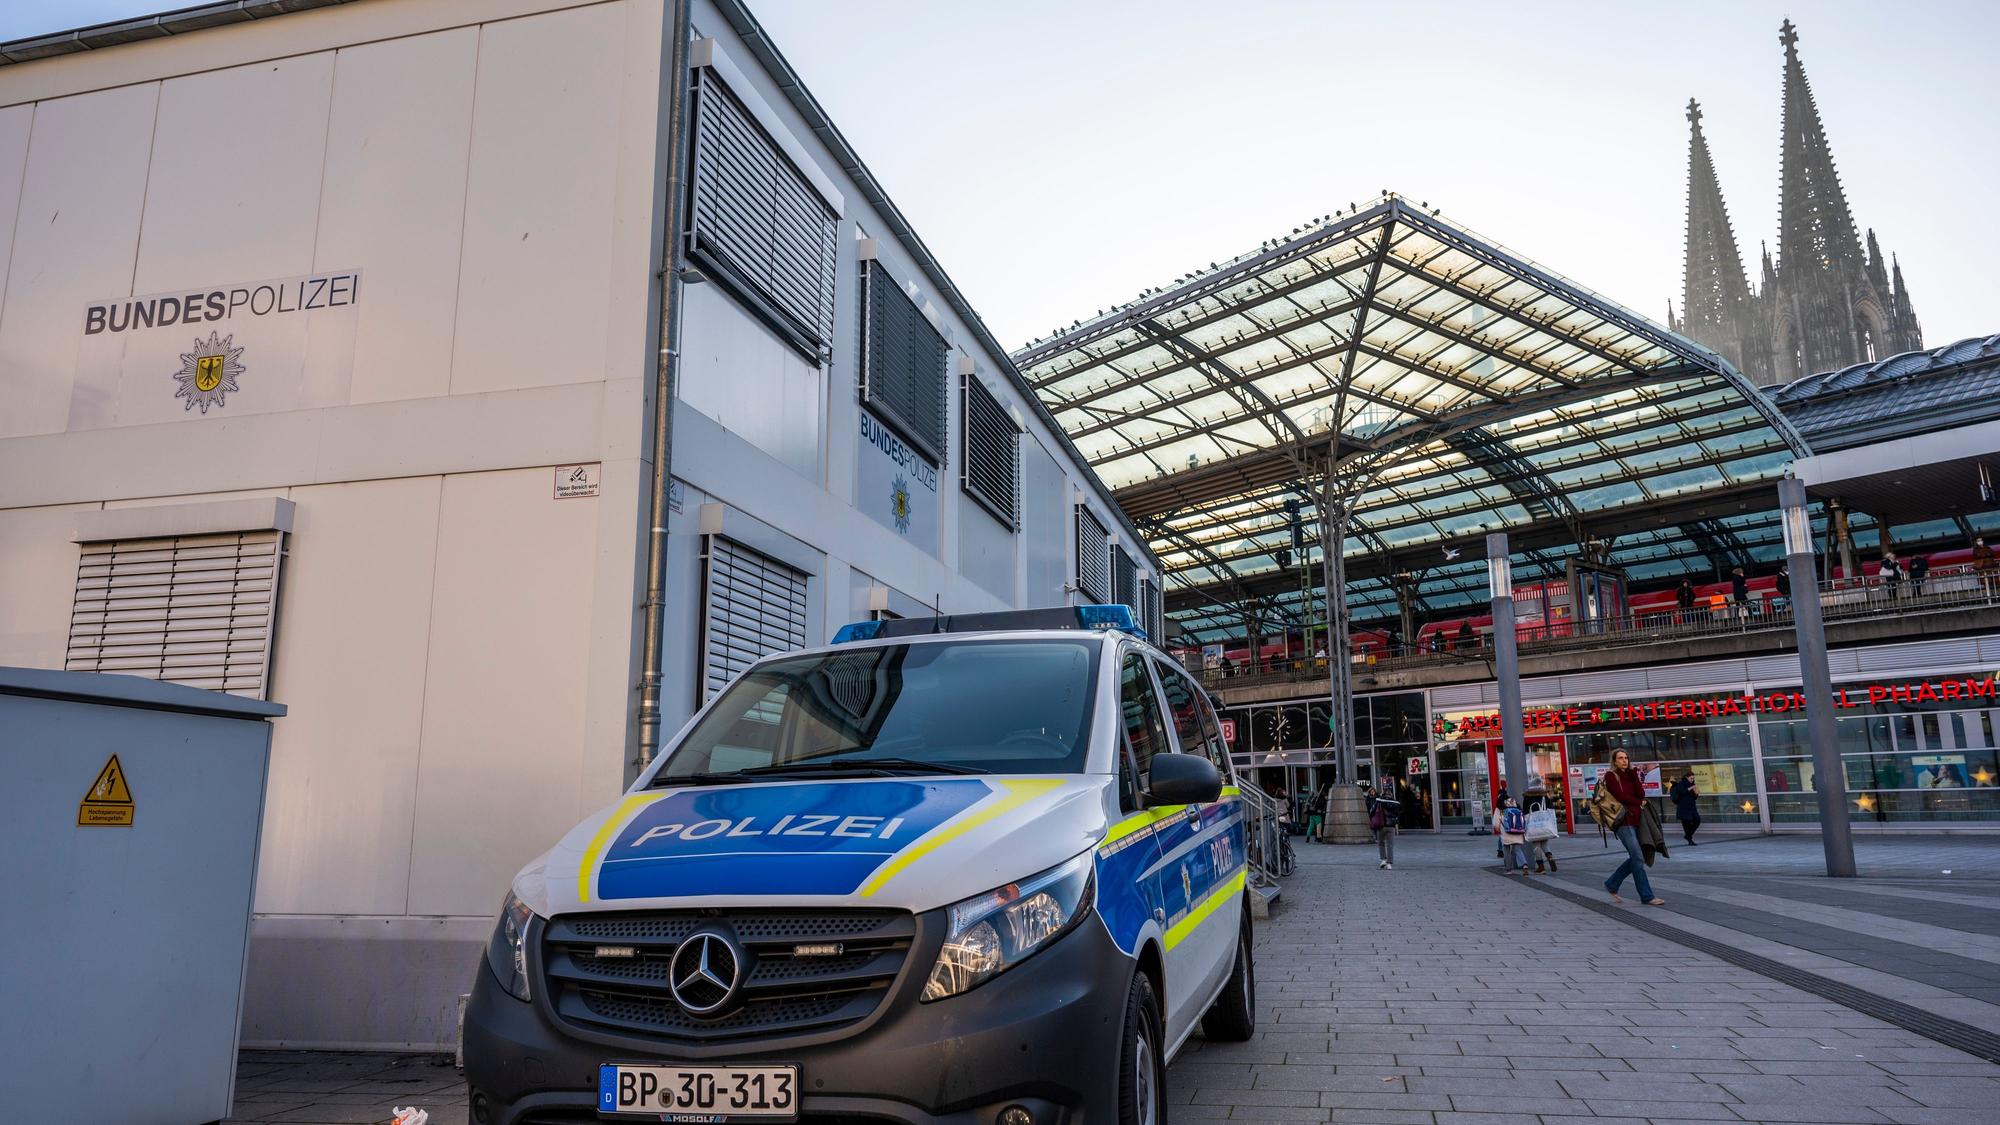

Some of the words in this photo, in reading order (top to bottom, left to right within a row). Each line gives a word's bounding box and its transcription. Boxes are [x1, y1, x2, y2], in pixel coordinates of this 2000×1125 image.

[85, 274, 358, 336] BUNDESPOLIZEI
[861, 412, 937, 493] BUNDESPOLIZEI
[1619, 687, 1856, 723] INTERNATIONL
[630, 814, 905, 847] POLIZEI
[605, 1093, 612, 1103] D
[619, 1072, 658, 1107] BP
[676, 1073, 792, 1108] 30-313
[673, 1115, 716, 1123] MOSOLF
